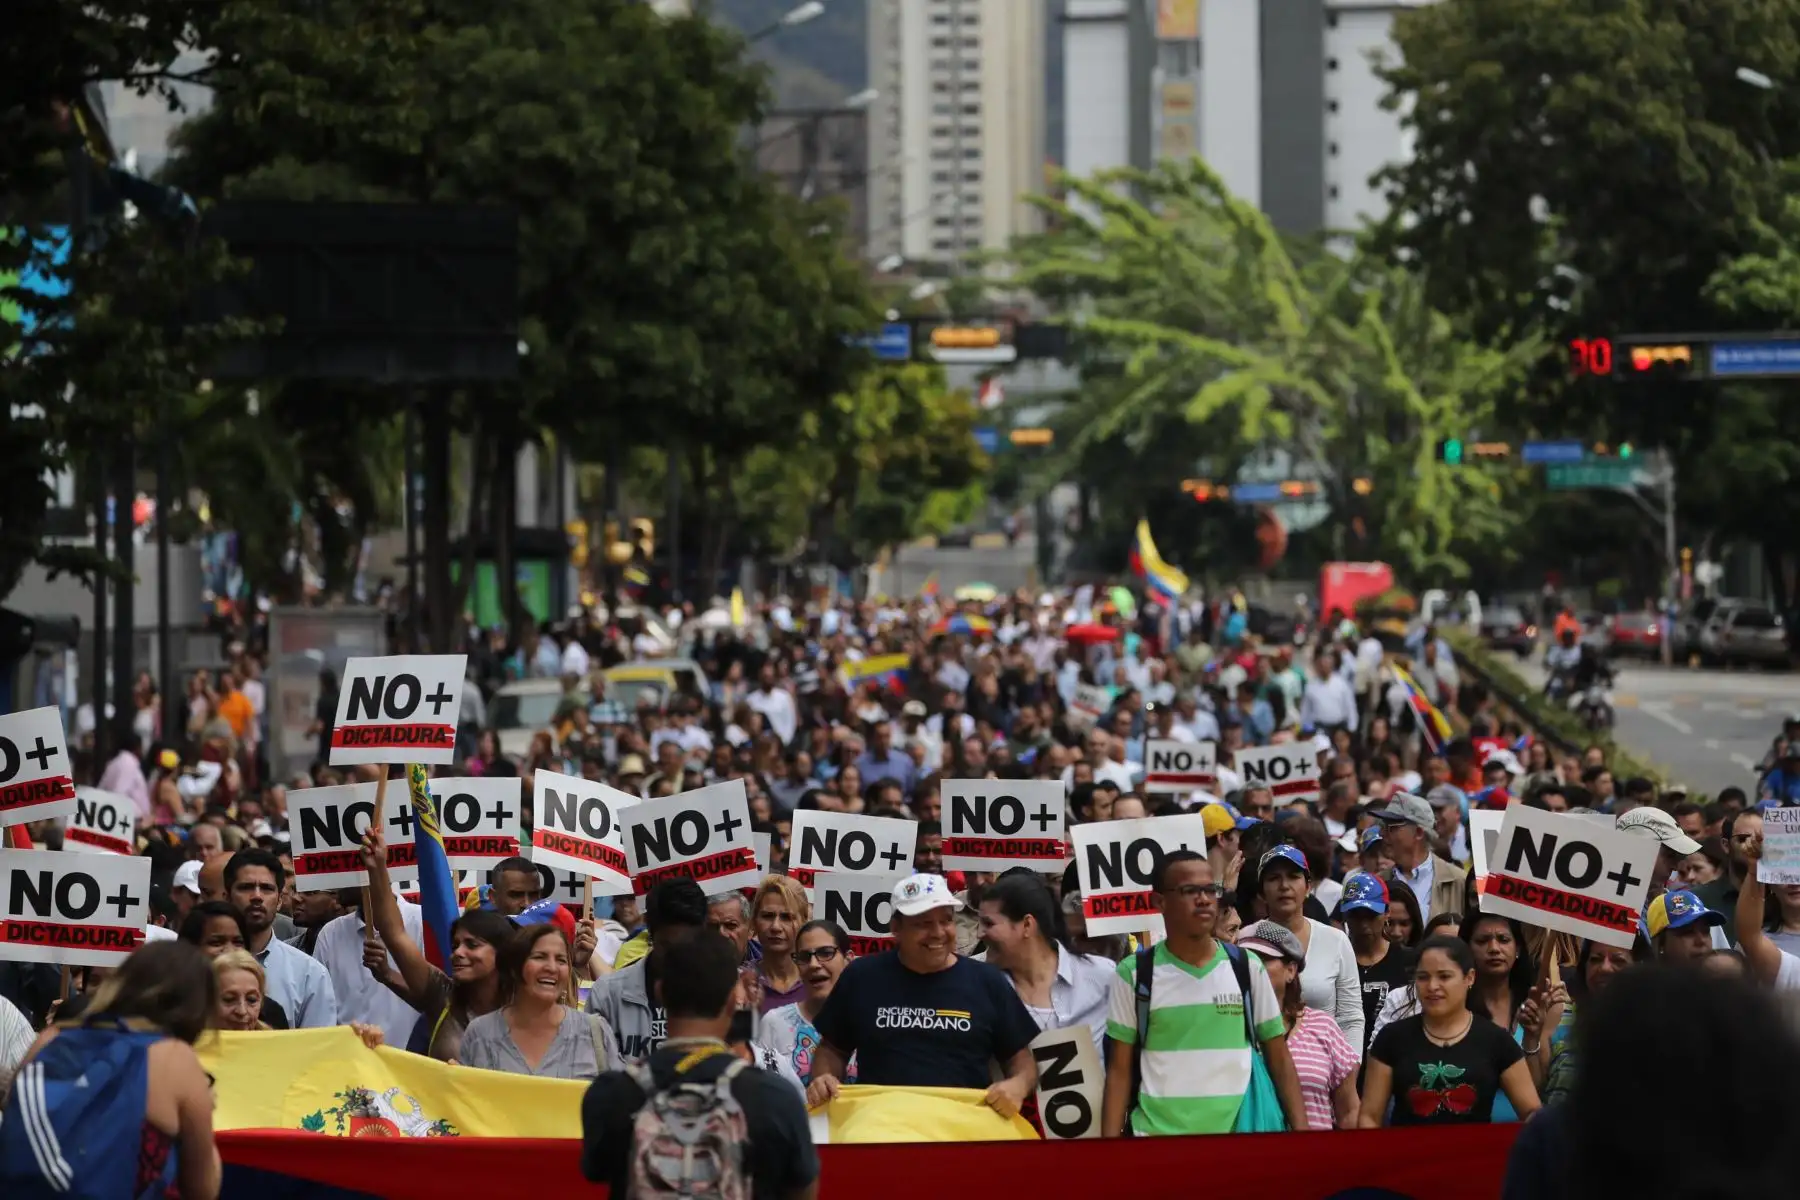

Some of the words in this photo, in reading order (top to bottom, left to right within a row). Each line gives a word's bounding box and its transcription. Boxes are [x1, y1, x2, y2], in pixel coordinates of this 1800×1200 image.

[343, 727, 447, 745] DICTADURA
[1765, 808, 1800, 823] AZON
[543, 832, 627, 872] DICTADURA
[952, 840, 1056, 856] DICTADURA
[1498, 878, 1629, 927] DICTADURA
[7, 923, 136, 947] DICTADURA
[877, 1007, 936, 1017] ENCUENTRO
[876, 1015, 971, 1032] CIUDADANO
